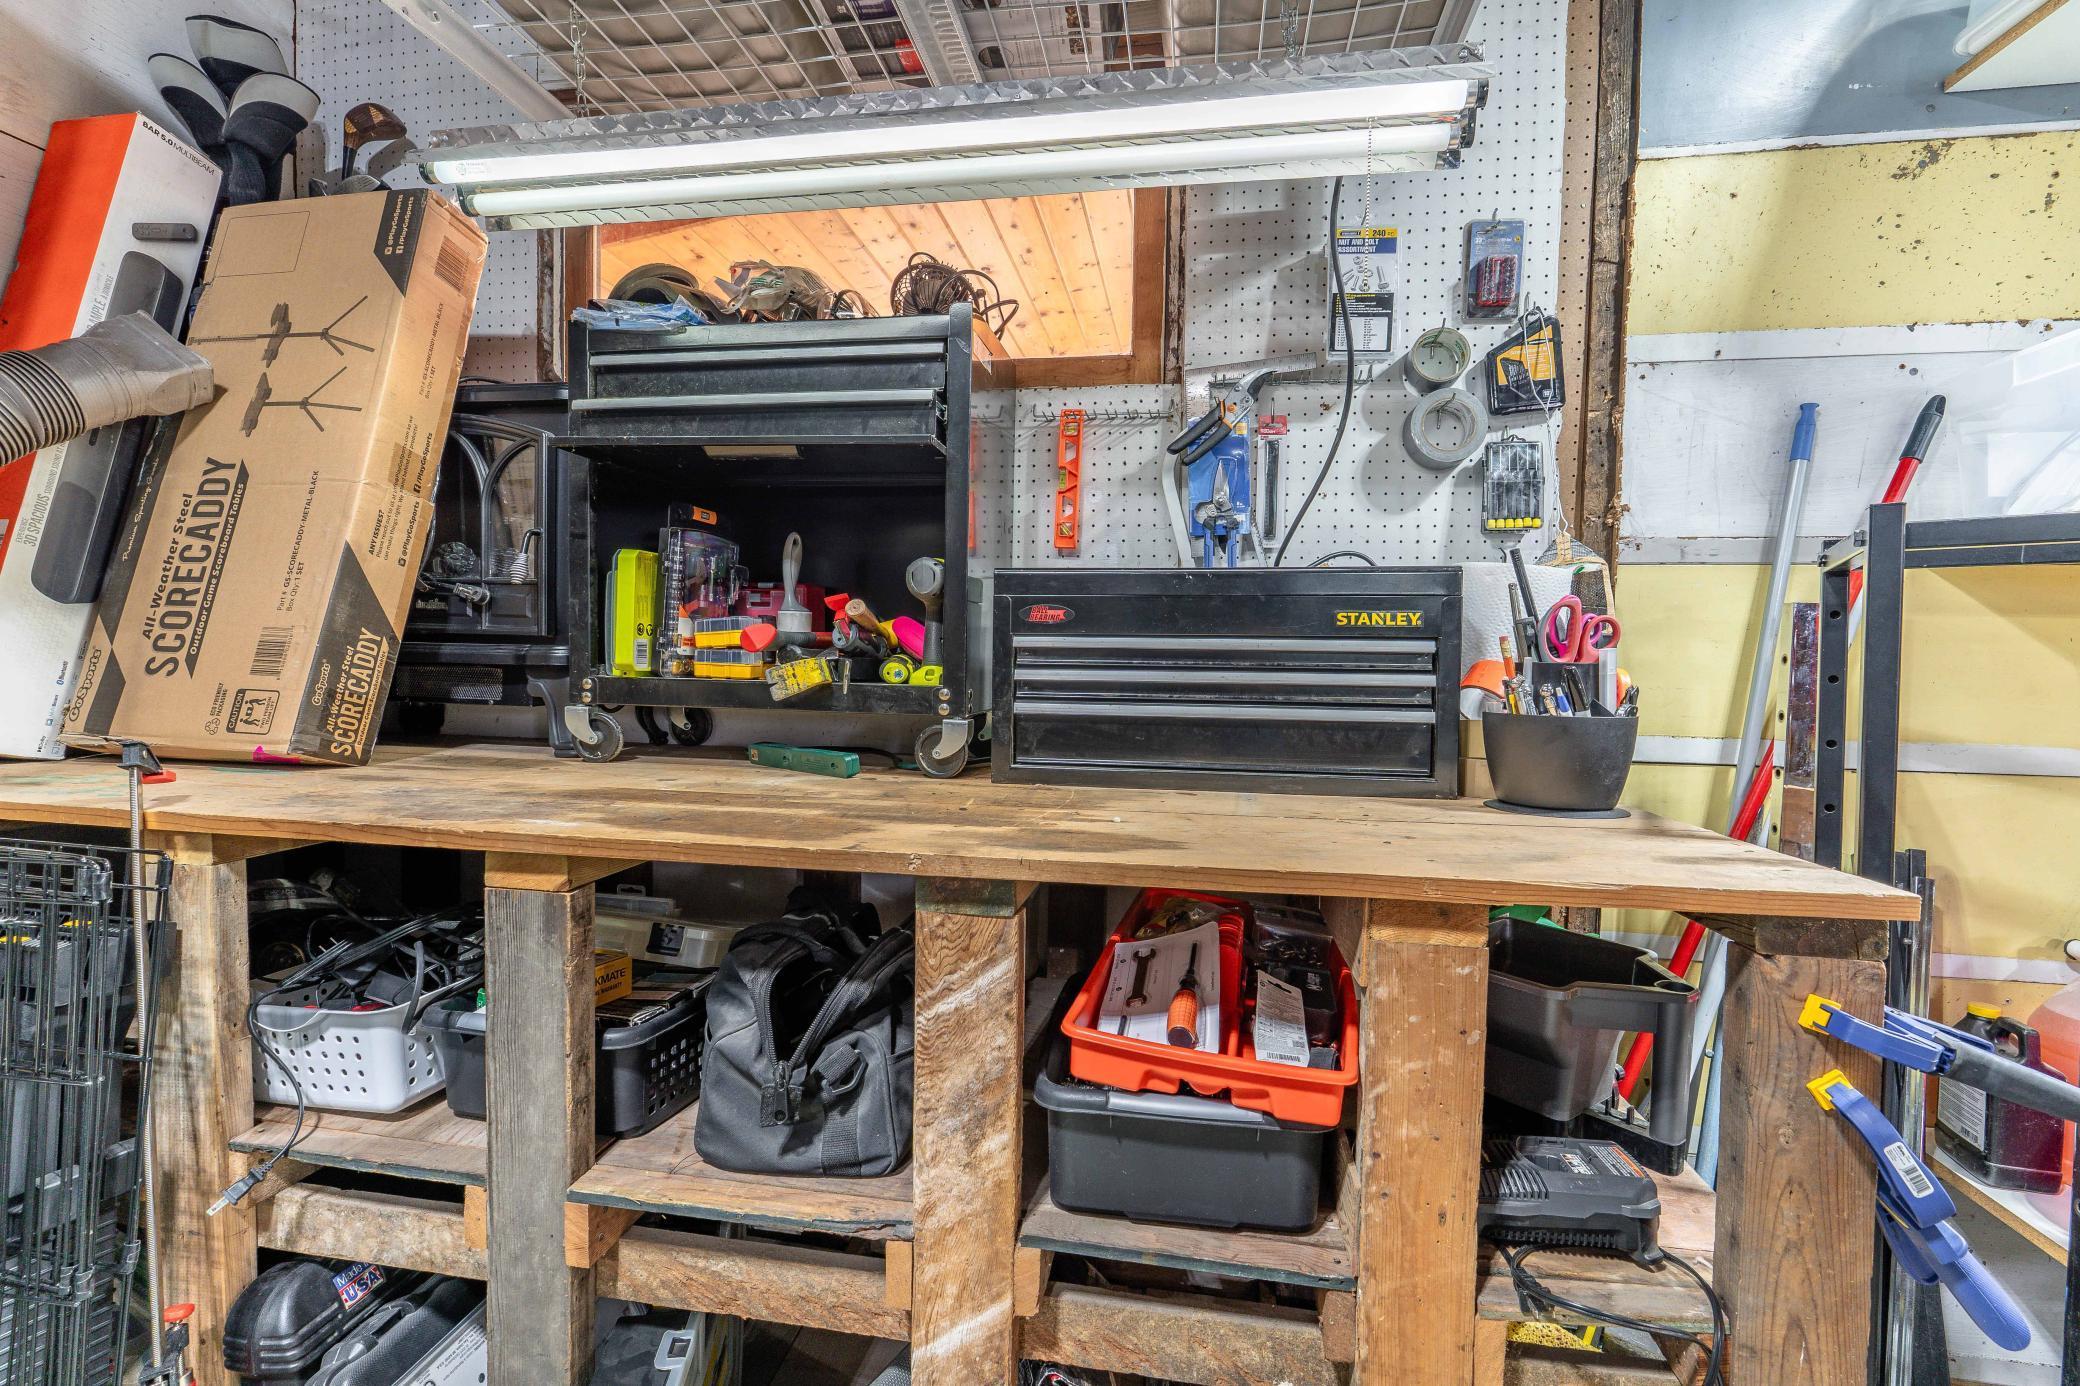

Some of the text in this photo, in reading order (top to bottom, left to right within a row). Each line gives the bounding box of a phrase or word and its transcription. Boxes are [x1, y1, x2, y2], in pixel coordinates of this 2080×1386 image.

[142, 121, 214, 176] BAR 5.0 MULTIBEAM
[388, 194, 404, 245] @PlayGoSports
[418, 432, 432, 485] /PlayGoSports
[24, 534, 37, 547] 3D
[29, 494, 50, 536] SPACIOUS
[368, 510, 385, 555] ANY ISSUES?
[403, 501, 419, 556] @PlayGoSports
[122, 522, 138, 562] Premium
[142, 493, 192, 640] All-Weather Steel
[277, 596, 286, 612] Part
[284, 470, 319, 588] GS-SCORECADDY-METAL-BLACK
[144, 456, 236, 678] SCORECADDY
[190, 482, 244, 655] Outdoor Game Scoreboard Tables
[286, 597, 294, 612] Box
[296, 561, 304, 576] SET
[1336, 612, 1420, 625] STANLEY
[69, 649, 101, 721] GoSports
[312, 663, 331, 706] GoSports
[327, 645, 355, 732] All-Weather Steel
[330, 627, 381, 756] SCORECADDY
[228, 693, 243, 728] CAUTION
[596, 968, 626, 986] KMATE
[337, 1265, 362, 1286] Made
[344, 1271, 380, 1302] USA
